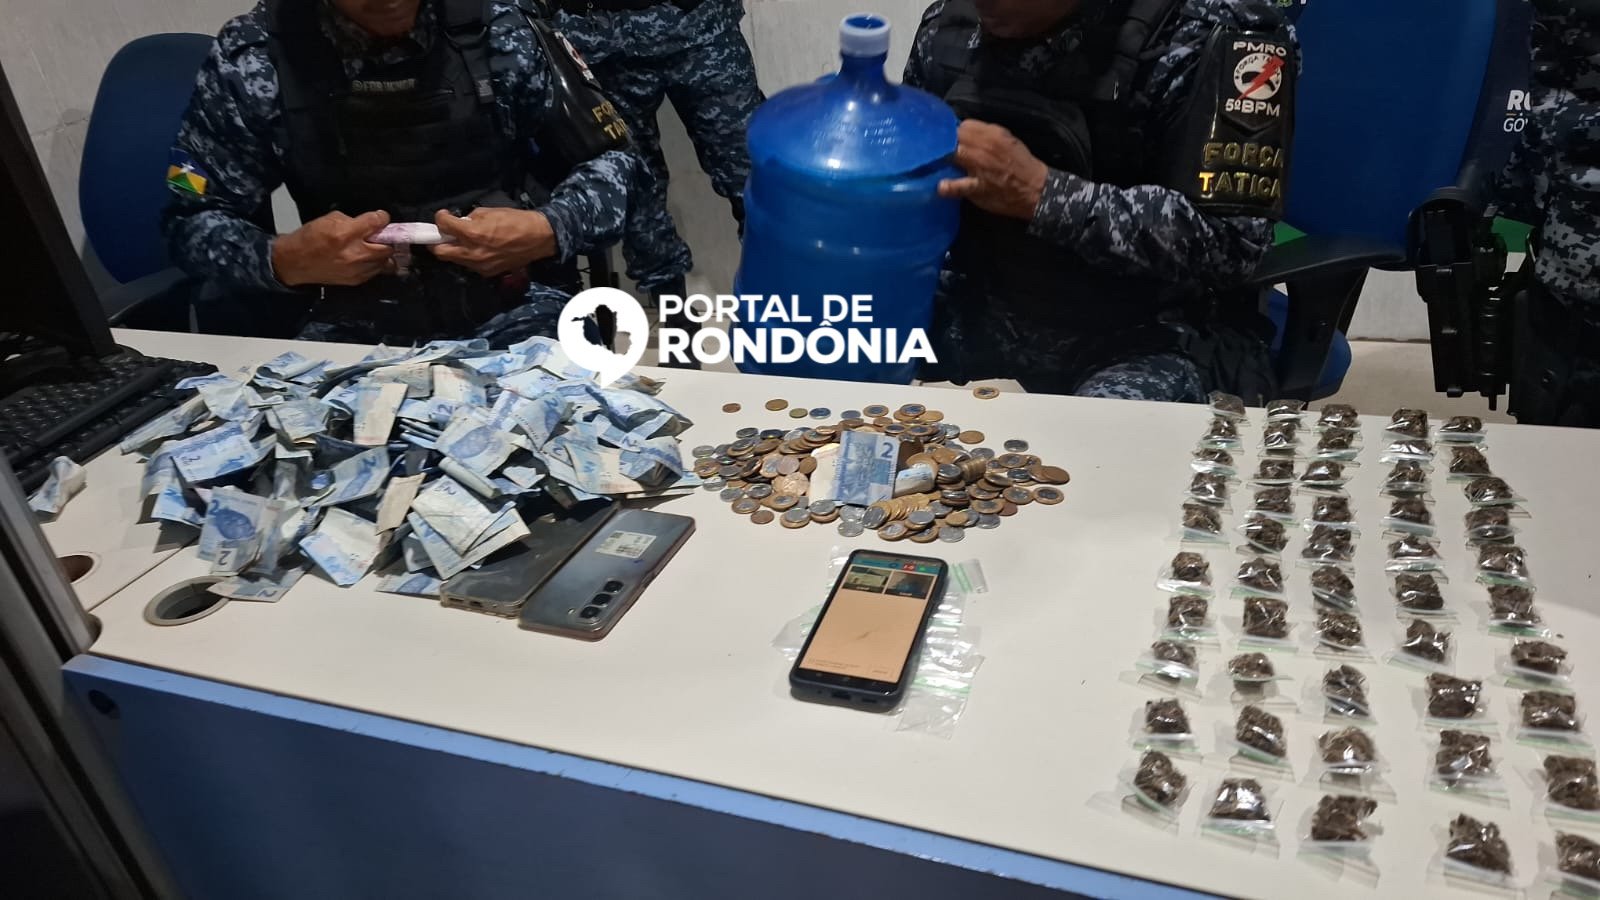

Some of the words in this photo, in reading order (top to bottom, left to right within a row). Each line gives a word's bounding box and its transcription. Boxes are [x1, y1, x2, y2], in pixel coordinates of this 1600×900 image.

[1233, 41, 1287, 57] PMRO
[881, 442, 894, 458] 2
[218, 550, 233, 566] 2
